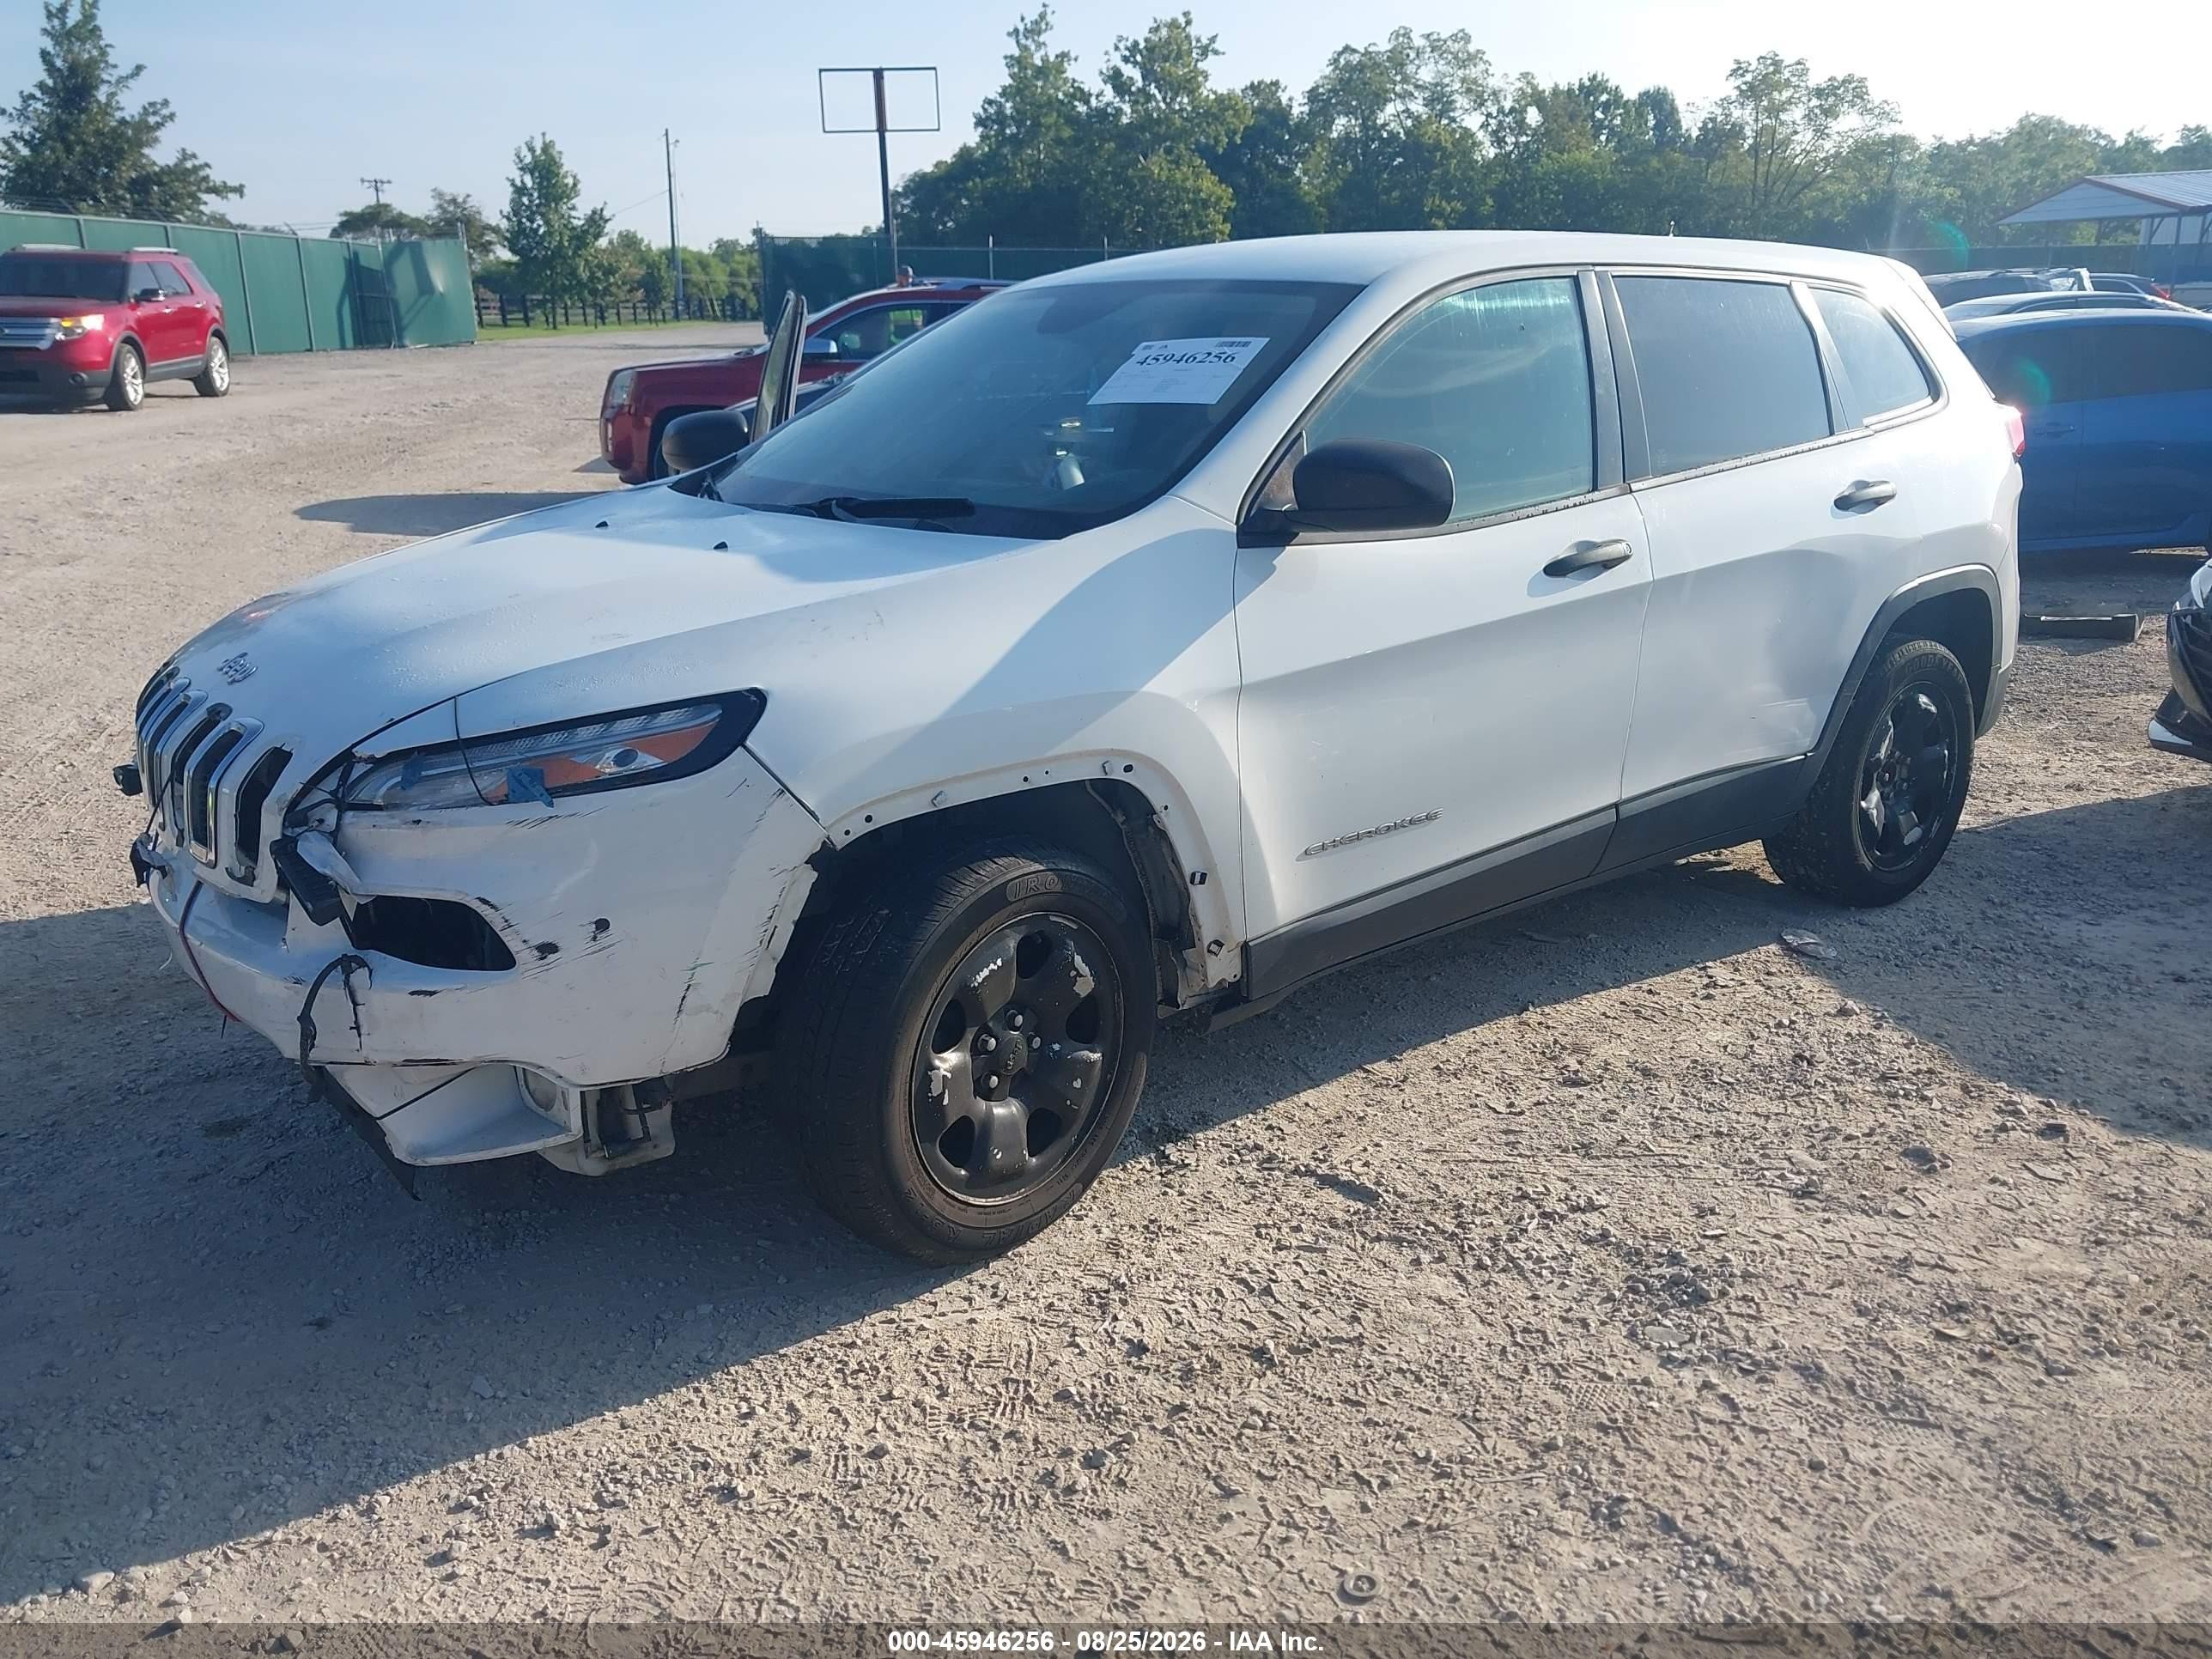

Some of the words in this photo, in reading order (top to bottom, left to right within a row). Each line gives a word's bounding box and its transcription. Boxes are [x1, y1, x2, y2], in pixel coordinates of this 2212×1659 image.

[1136, 351, 1240, 366] 45946256
[1304, 806, 1443, 856] CHEROKEE
[981, 1190, 1074, 1245] RADIAL
